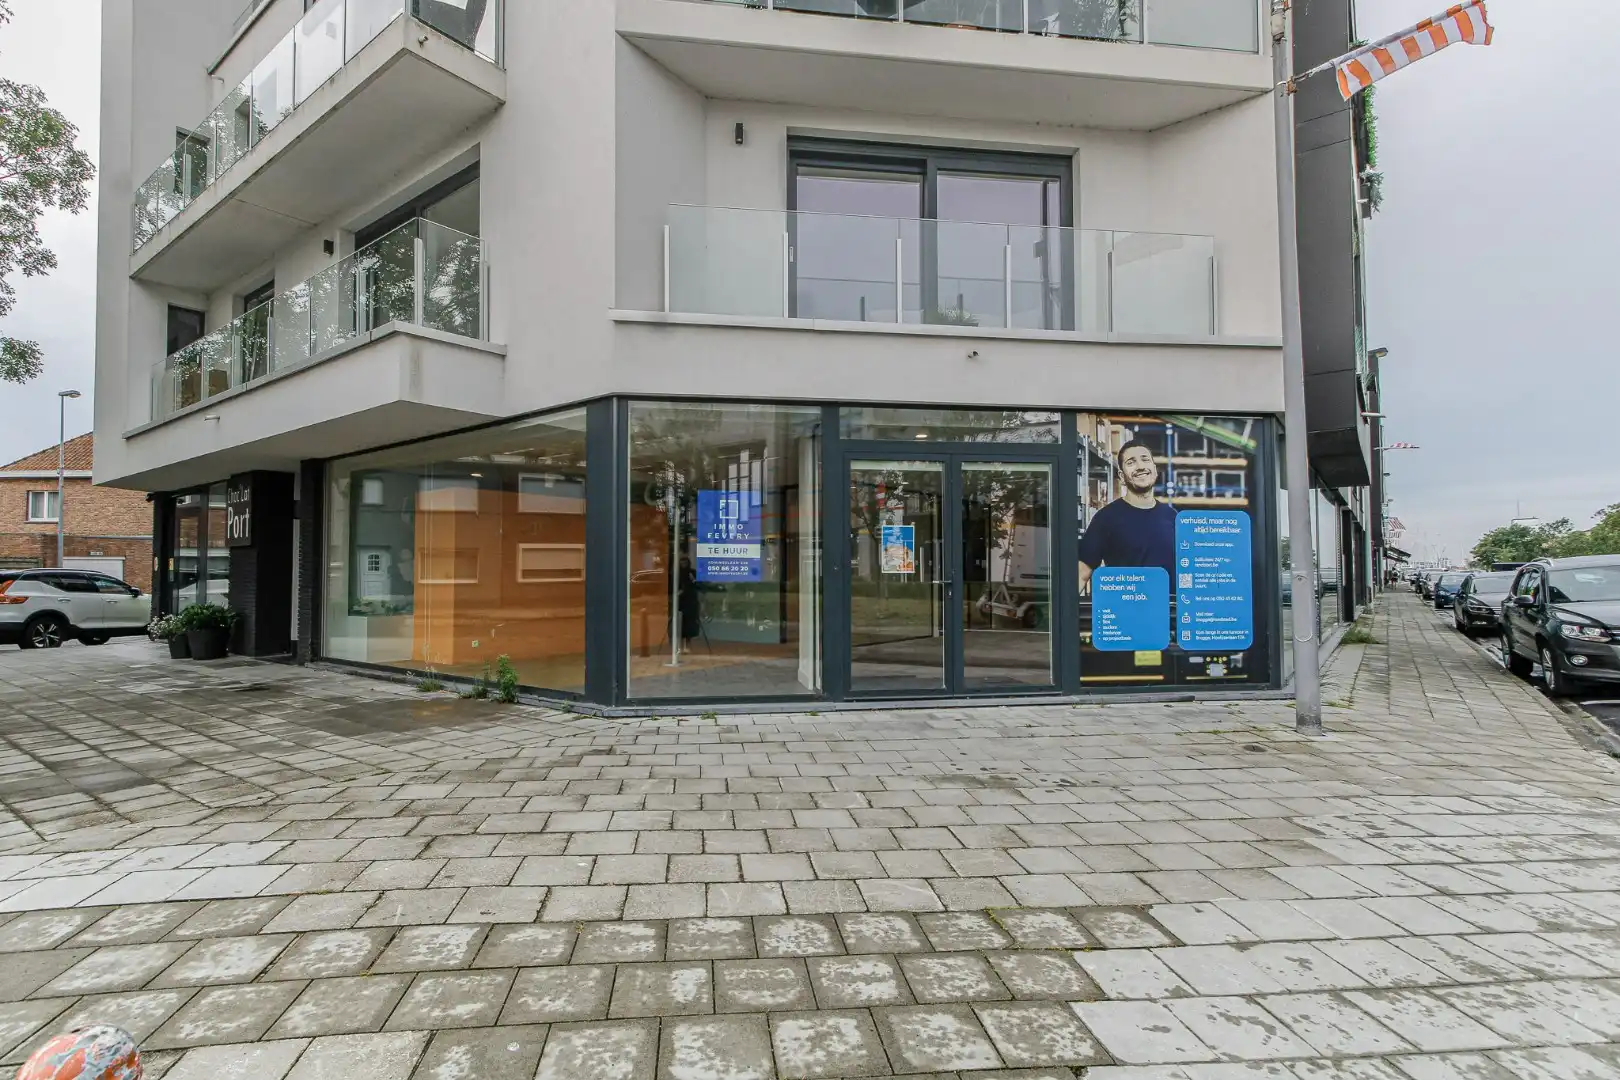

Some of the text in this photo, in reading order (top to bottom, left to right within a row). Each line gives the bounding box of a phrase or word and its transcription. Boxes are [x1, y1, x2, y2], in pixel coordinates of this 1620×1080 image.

[227, 506, 250, 539] Port
[707, 532, 750, 540] FEVERY
[722, 547, 749, 555] HUUR
[1115, 574, 1126, 582] elk
[1126, 574, 1146, 582] talent
[1100, 583, 1137, 592] hebben wij
[1134, 593, 1148, 602] job.
